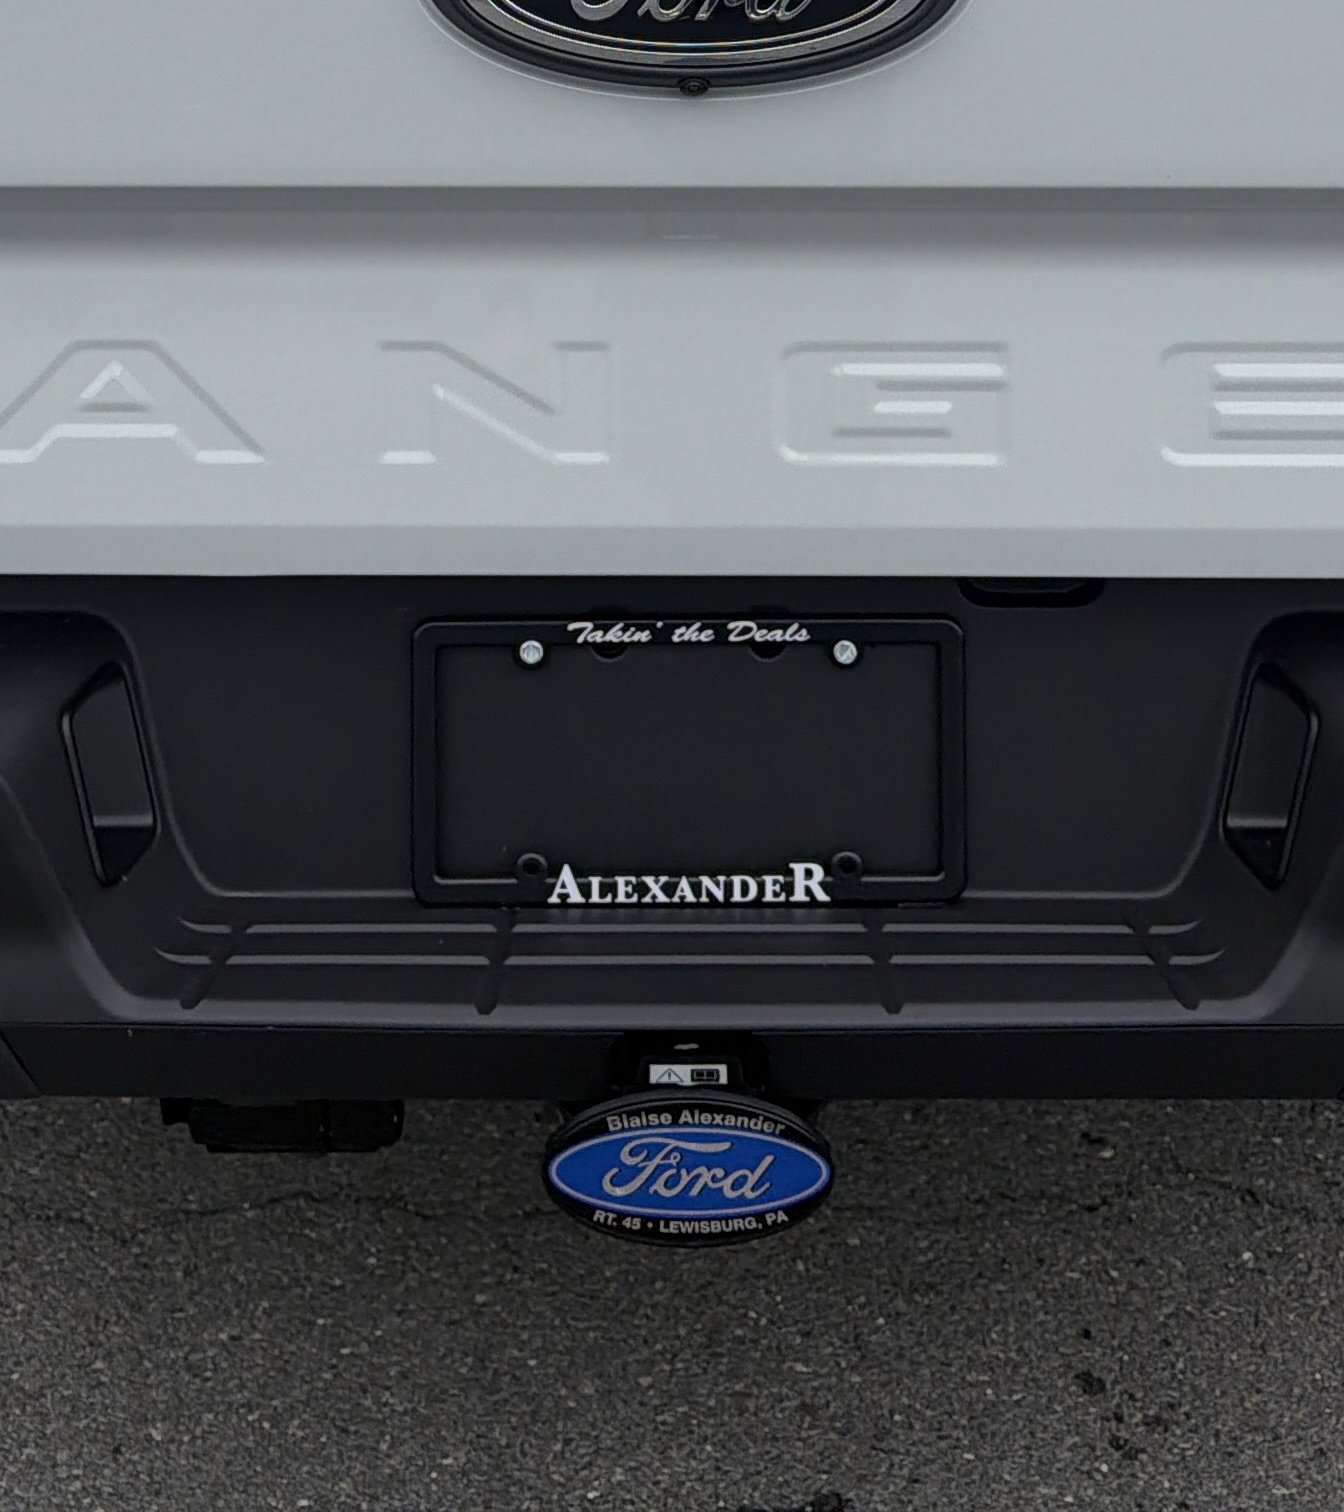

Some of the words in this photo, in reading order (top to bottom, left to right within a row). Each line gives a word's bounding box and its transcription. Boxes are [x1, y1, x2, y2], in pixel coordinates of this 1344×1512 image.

[566, 620, 664, 644] Takin'
[671, 621, 716, 642] the
[726, 620, 811, 642] Deals
[547, 862, 831, 904] ALEXANDER
[606, 1109, 673, 1133] Blaise
[678, 1109, 786, 1136] Alexander
[601, 1136, 775, 1200] Ford
[592, 1209, 616, 1227] RT.
[621, 1216, 642, 1231] 45
[659, 1217, 763, 1234] LEWISBURG,
[766, 1209, 789, 1226] PA
